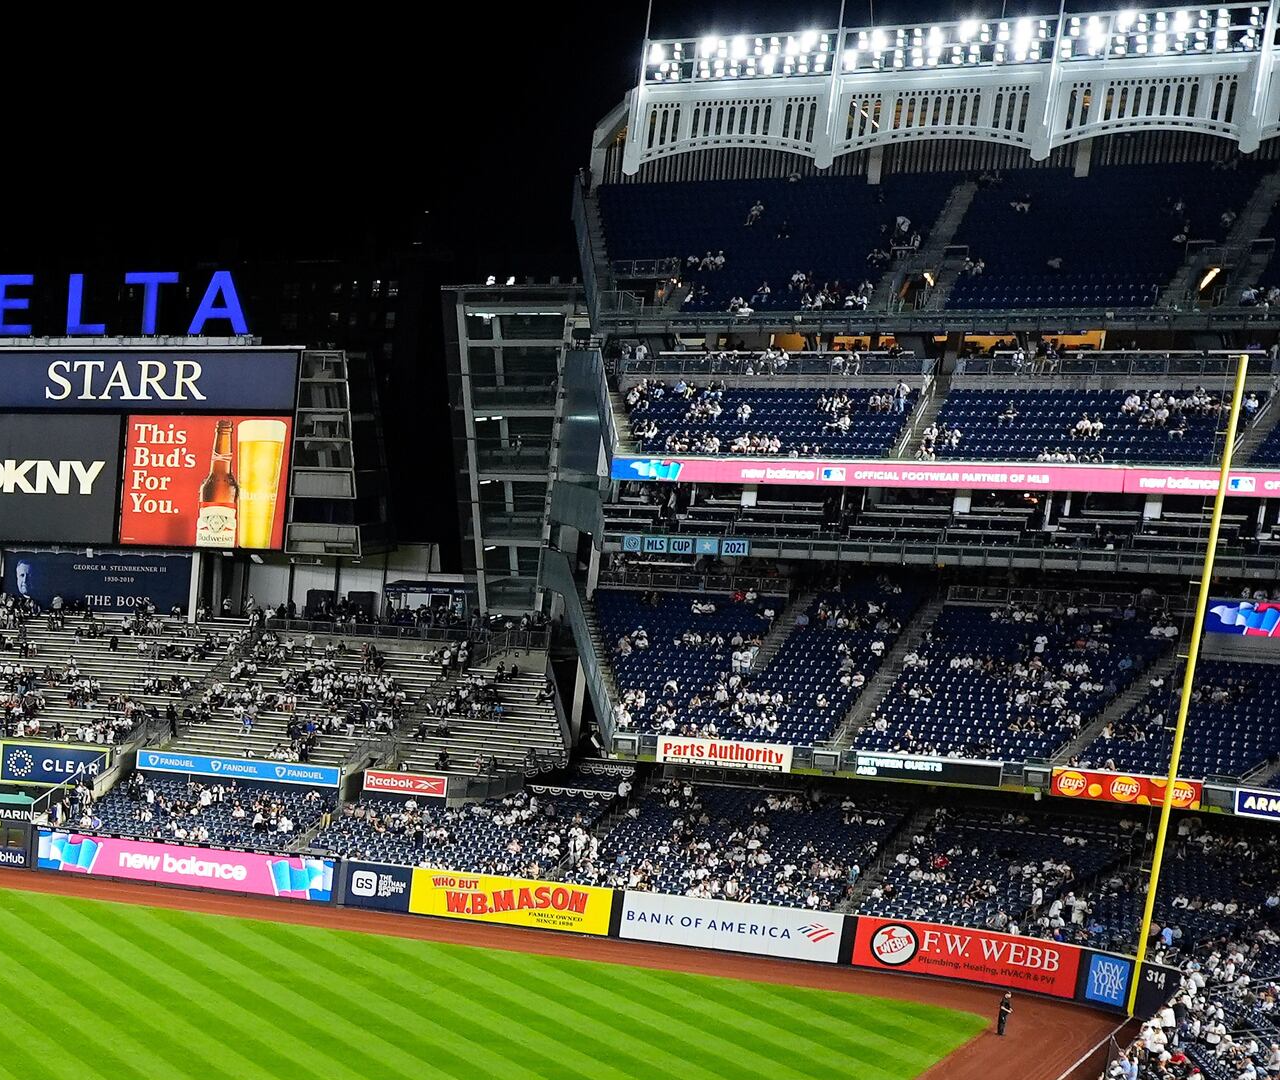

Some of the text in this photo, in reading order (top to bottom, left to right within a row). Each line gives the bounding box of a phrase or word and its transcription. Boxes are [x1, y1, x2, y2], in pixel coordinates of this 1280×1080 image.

[46, 361, 206, 400] STARR
[135, 424, 187, 444] This
[133, 447, 196, 467] Bud's
[132, 470, 171, 490] For
[131, 493, 179, 513] You.
[646, 538, 746, 555] MLS CUP 2021
[85, 595, 150, 606] THE BOSS
[663, 742, 783, 764] Parts Authority
[42, 759, 100, 775] CLEAR
[160, 758, 194, 768] FANDUEL
[223, 763, 257, 773] FANDUEL
[288, 770, 323, 780] FANDUEL
[367, 776, 413, 788] Reebok
[119, 850, 247, 881] new balance
[433, 877, 479, 889] WHO BUT
[627, 911, 790, 939] BANK OF AMERICA
[920, 931, 1059, 972] F.W. WEBB
[1098, 960, 1122, 975] NEW
[1092, 971, 1125, 990] YORK
[1093, 983, 1118, 1000] LIFE
